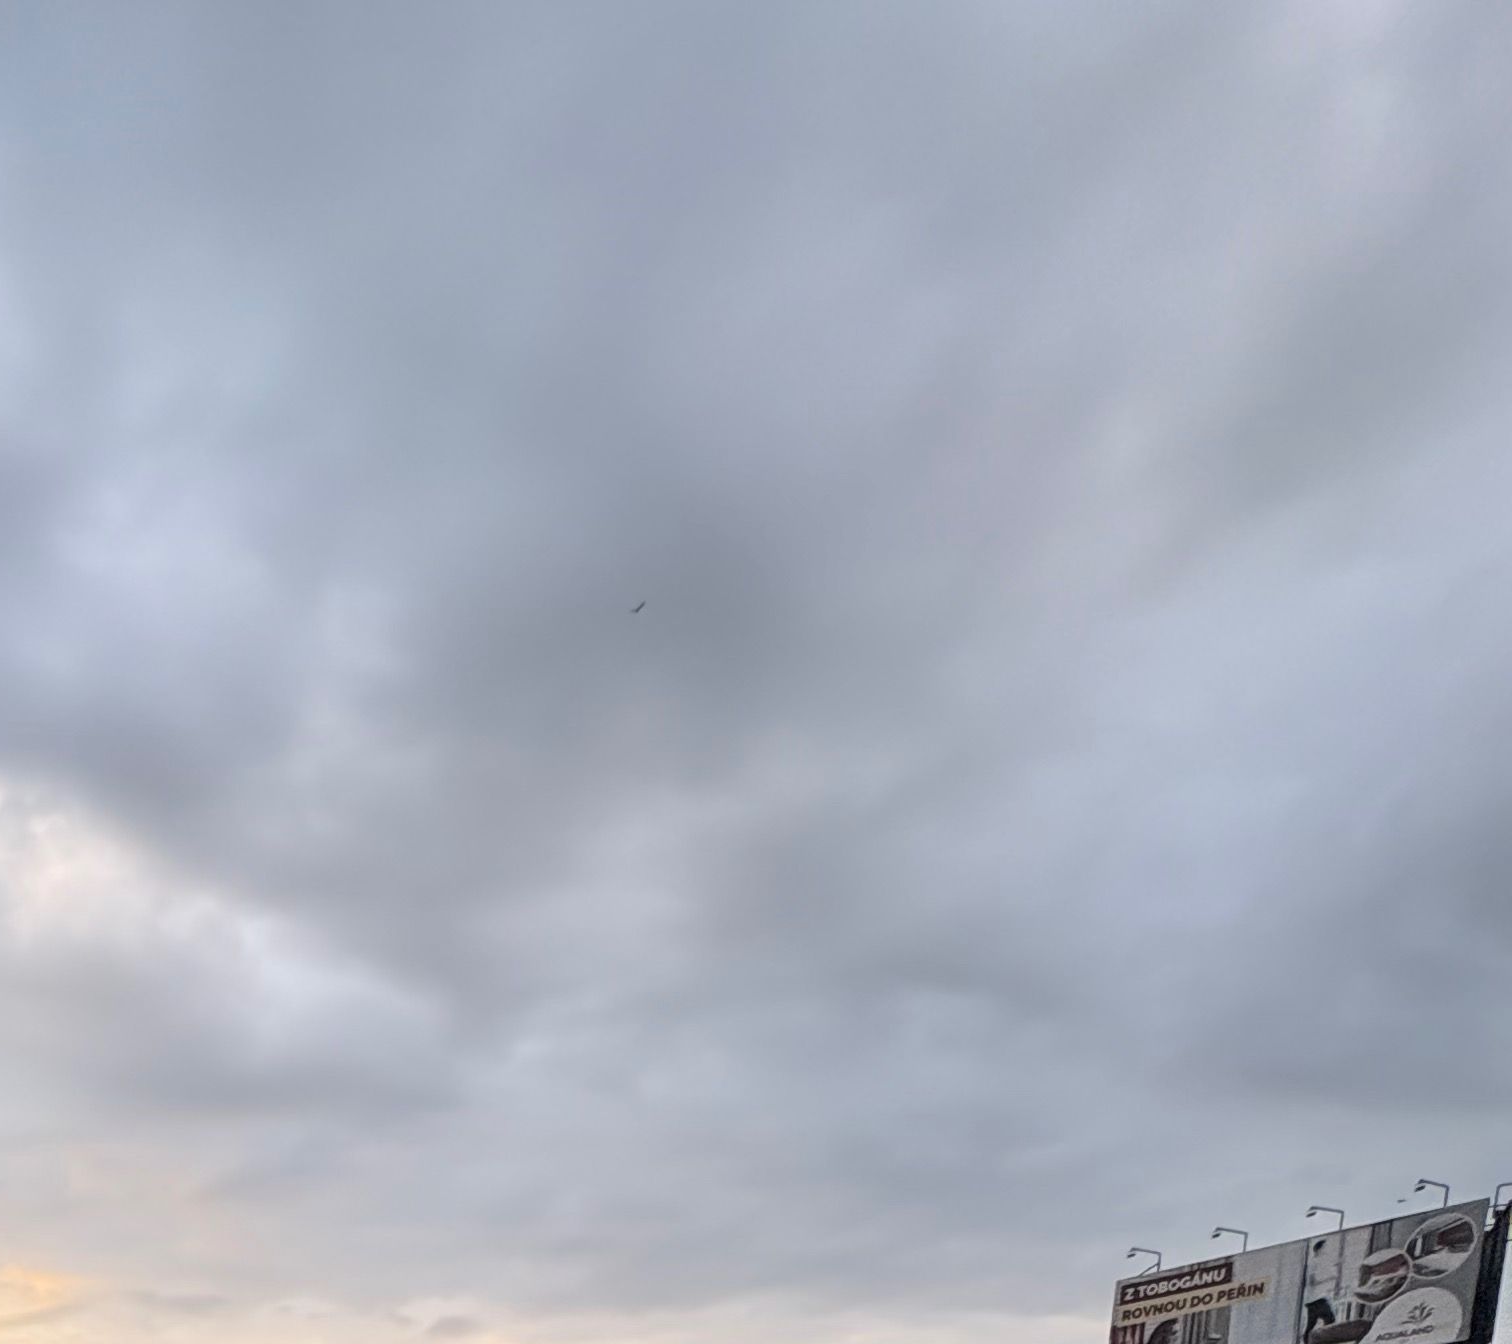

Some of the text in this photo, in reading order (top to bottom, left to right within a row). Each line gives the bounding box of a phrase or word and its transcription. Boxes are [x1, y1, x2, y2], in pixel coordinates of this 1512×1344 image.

[1122, 1282, 1264, 1321] ROVNOU DO PEŘIN
[1123, 1268, 1227, 1301] Z TOBOGÁNU
